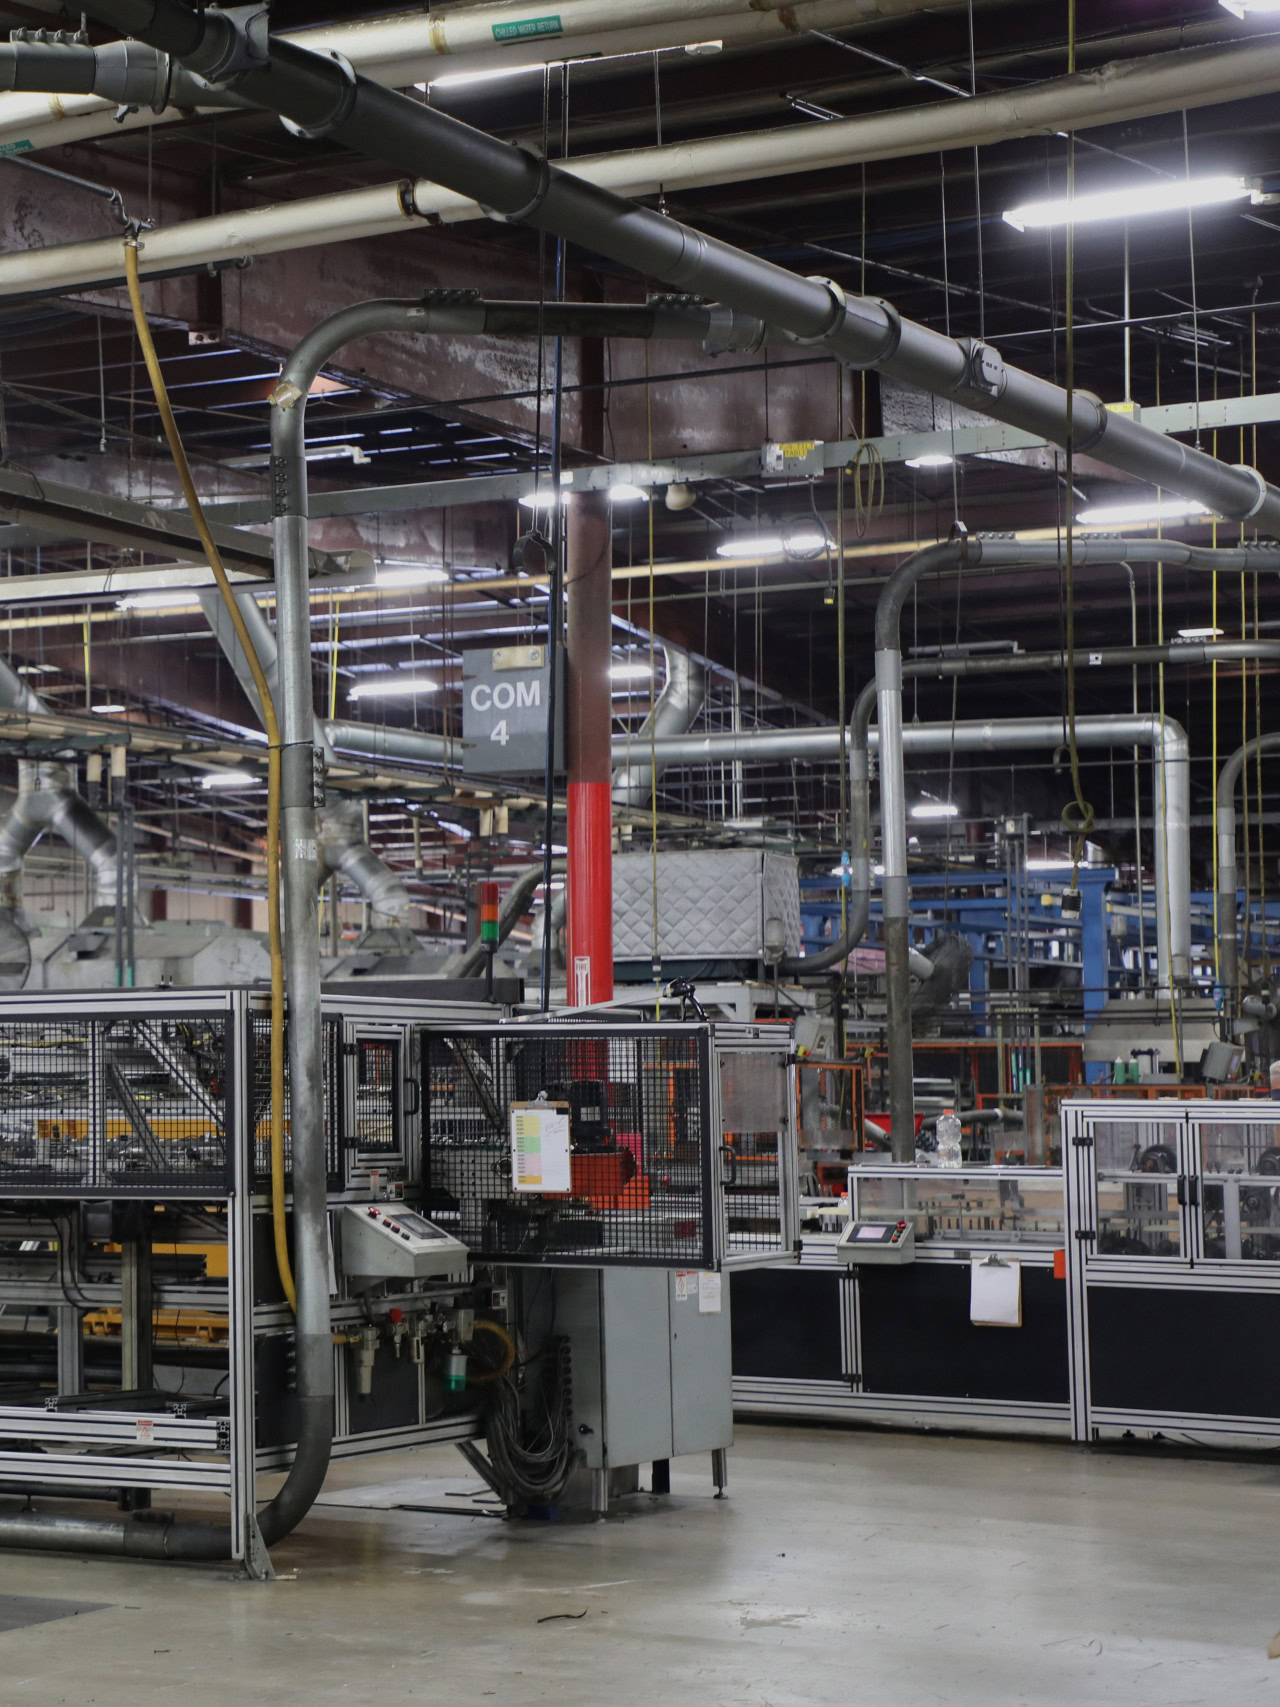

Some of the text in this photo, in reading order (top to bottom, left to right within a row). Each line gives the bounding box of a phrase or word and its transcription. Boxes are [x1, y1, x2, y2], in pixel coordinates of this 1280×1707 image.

[495, 20, 559, 38] CHILLED WATER RETURN
[470, 680, 541, 711] COM
[490, 720, 510, 746] 4
[576, 963, 587, 971] FIRE
